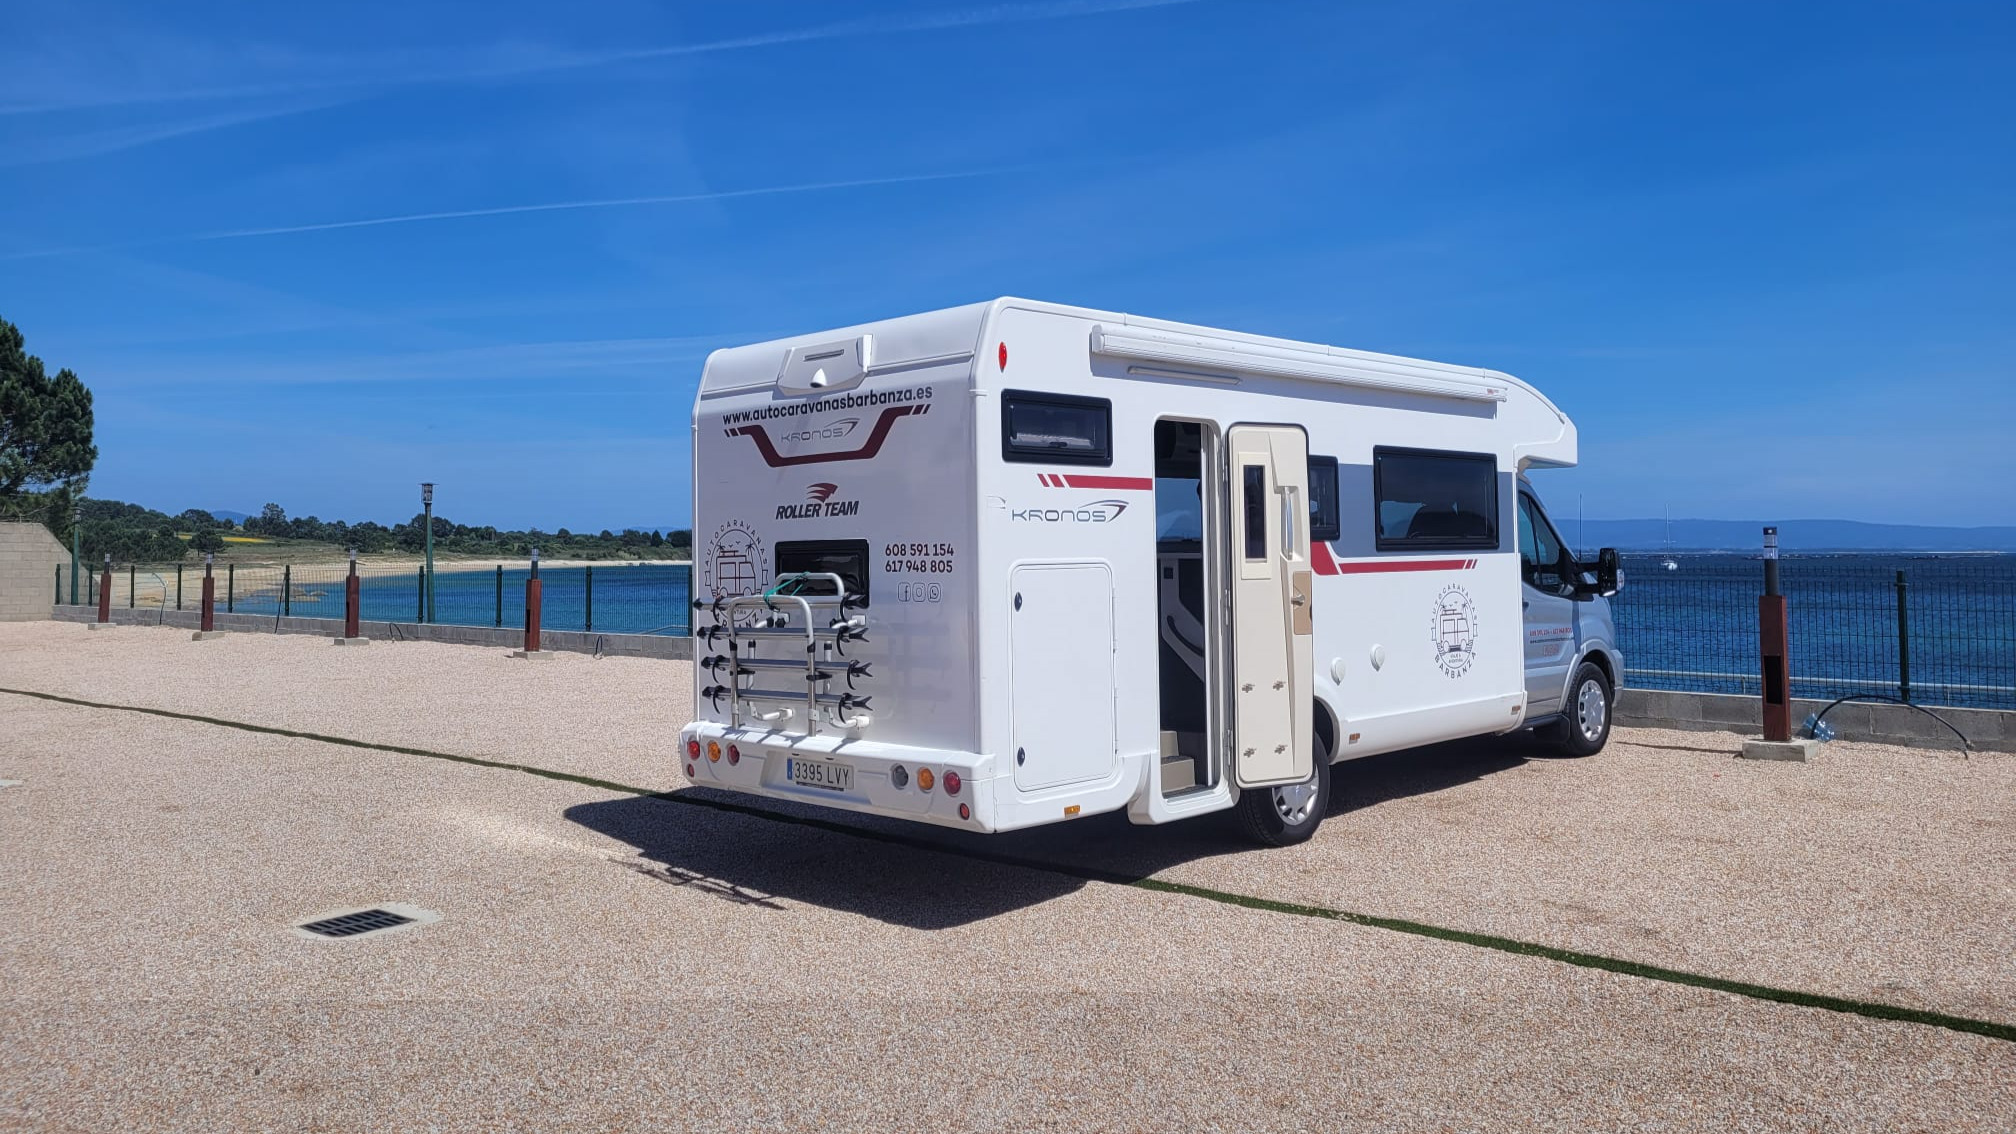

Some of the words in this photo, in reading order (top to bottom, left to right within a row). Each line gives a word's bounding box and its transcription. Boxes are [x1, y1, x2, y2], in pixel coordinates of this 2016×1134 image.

[722, 386, 933, 425] www.autocaravanasbarbanza.es
[781, 426, 846, 443] KRONOS
[776, 503, 822, 520] ROLLER
[824, 501, 860, 517] TEAM
[1012, 507, 1110, 523] KRONOS
[704, 519, 768, 567] AUTOCARAVANAS
[885, 543, 907, 557] 608
[910, 543, 930, 557] 591
[932, 543, 954, 557] 154
[885, 560, 903, 573] 617
[906, 560, 927, 573] 948
[930, 560, 953, 573] 805
[1434, 652, 1477, 679] BARBANZA
[794, 762, 823, 782] 3395
[827, 766, 849, 786] LVY
